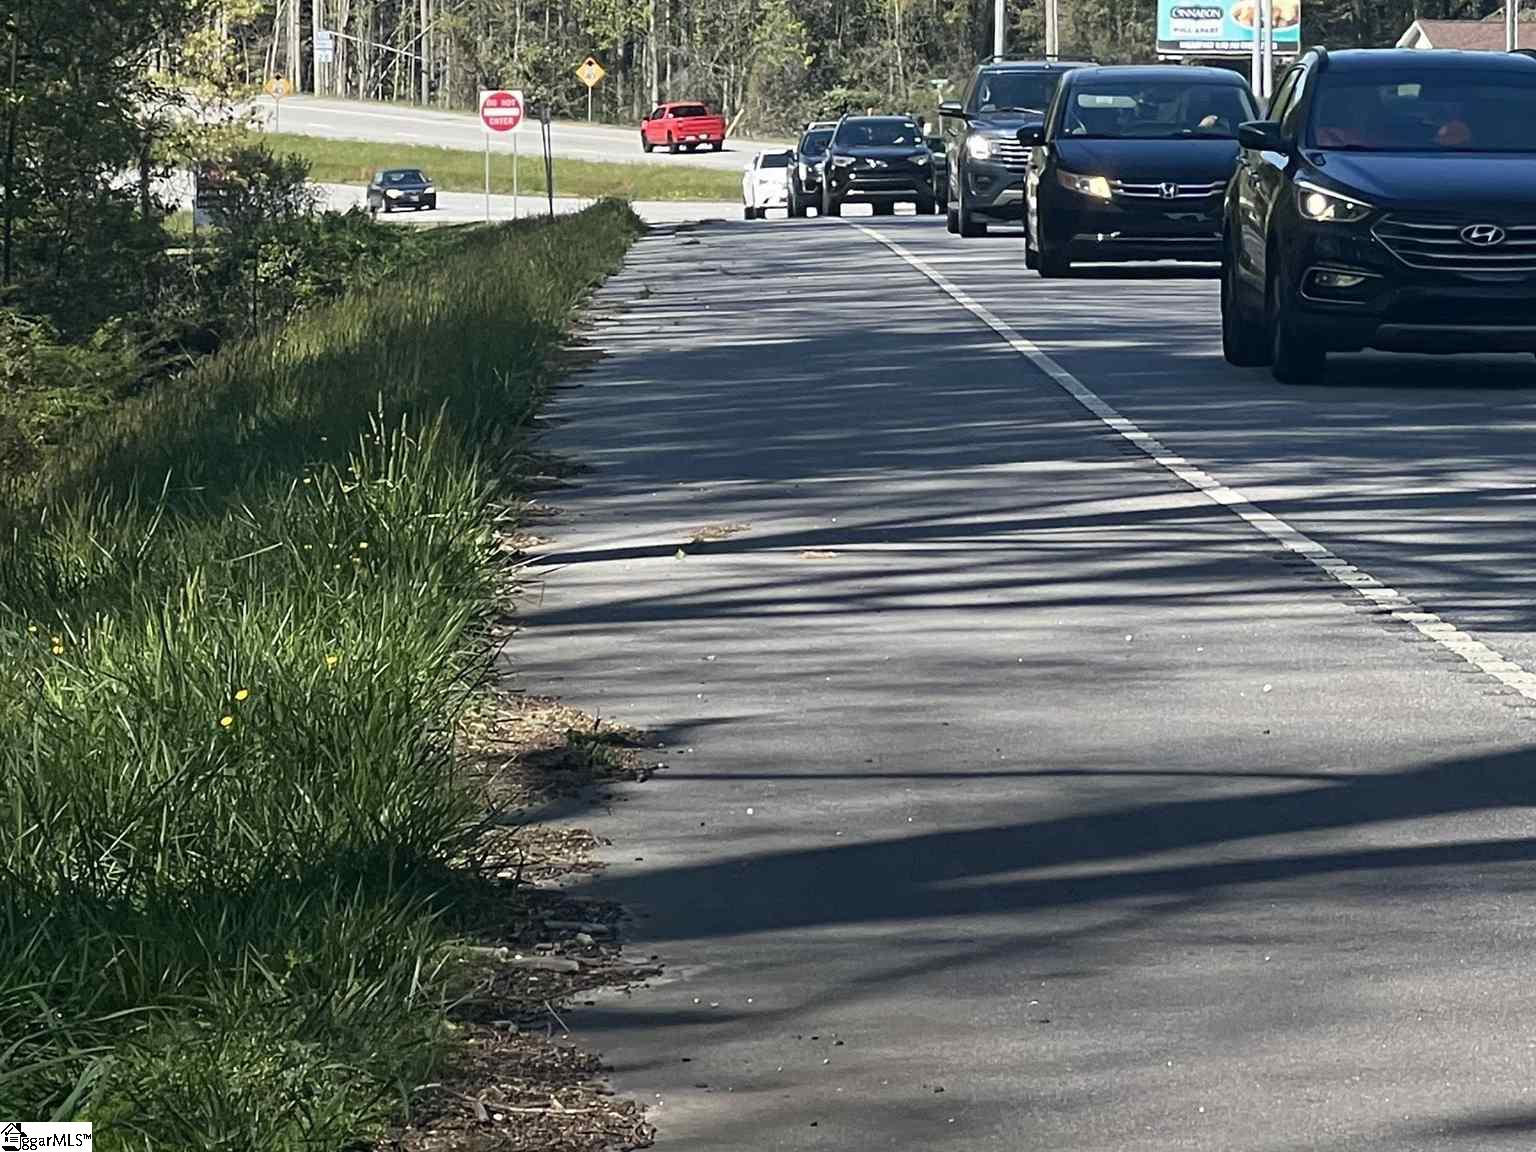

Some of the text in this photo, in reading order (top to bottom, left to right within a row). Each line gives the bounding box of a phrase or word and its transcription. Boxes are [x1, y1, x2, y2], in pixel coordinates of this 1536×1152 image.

[1172, 8, 1221, 18] CINNABON
[486, 98, 516, 106] DO NOT
[488, 117, 514, 126] ENTER
